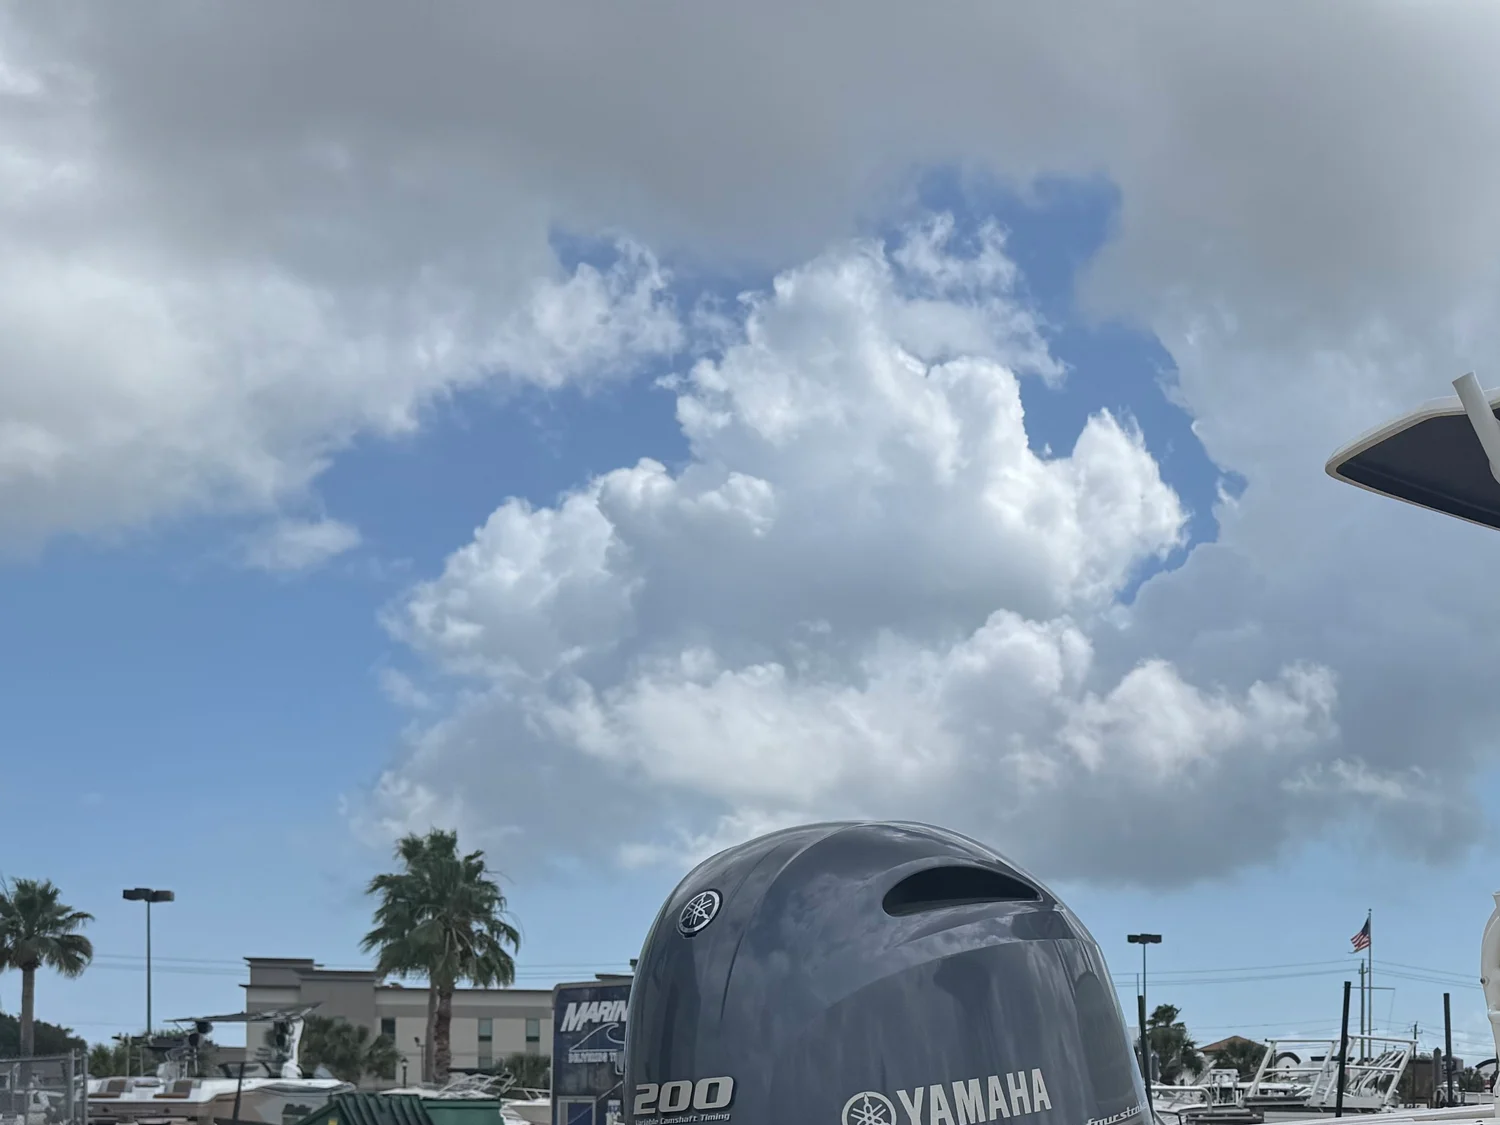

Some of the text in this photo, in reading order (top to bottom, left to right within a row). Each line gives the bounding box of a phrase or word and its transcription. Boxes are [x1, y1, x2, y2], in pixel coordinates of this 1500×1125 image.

[560, 1000, 628, 1032] MARIN
[633, 1076, 734, 1115] 200
[660, 1115, 698, 1125] Camshaft
[700, 1113, 731, 1122] Timing
